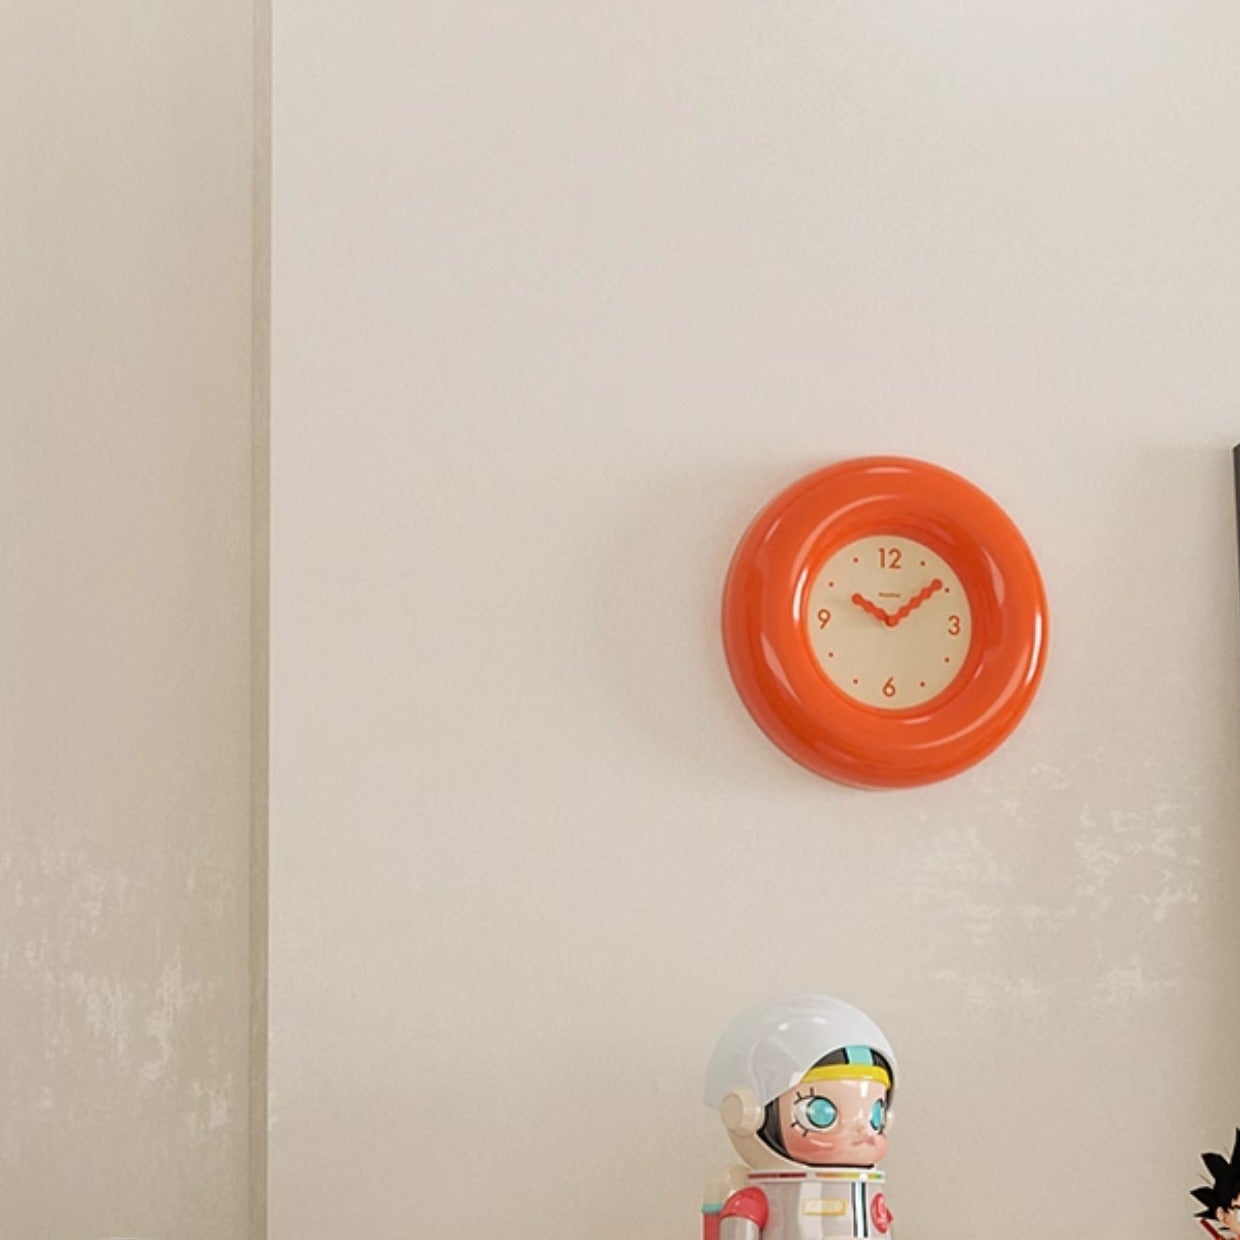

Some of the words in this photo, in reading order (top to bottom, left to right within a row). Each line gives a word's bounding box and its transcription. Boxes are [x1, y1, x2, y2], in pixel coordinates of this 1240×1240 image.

[878, 548, 902, 569] 12
[818, 608, 831, 629] 9
[948, 615, 961, 636] 3
[882, 676, 896, 698] 6
